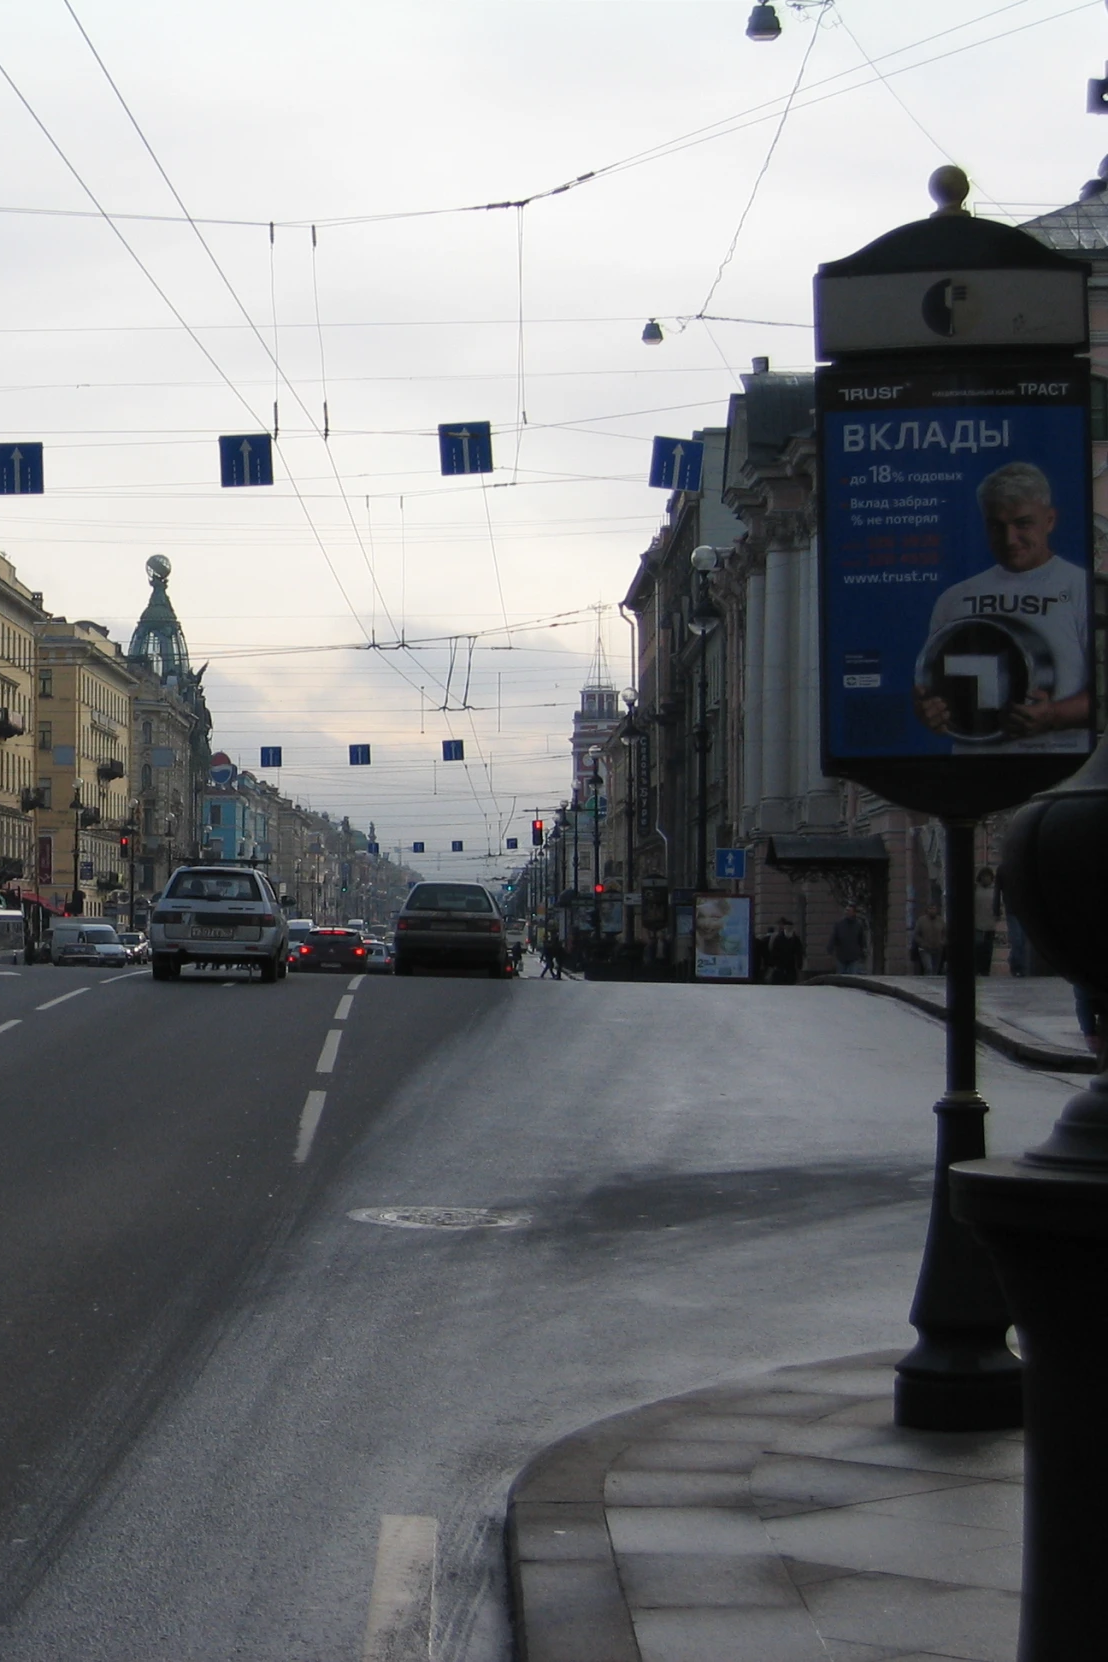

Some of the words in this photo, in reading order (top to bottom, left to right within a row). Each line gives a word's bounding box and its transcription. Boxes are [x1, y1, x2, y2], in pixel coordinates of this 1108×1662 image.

[838, 386, 904, 401] TRUST
[1018, 382, 1069, 396] ТРАСТ
[843, 420, 1010, 454] ВКЛАДЫ
[849, 475, 867, 487] до
[908, 471, 964, 484] годовых
[850, 497, 890, 510] Вклад
[893, 495, 937, 510] забрал
[867, 516, 882, 525] не
[886, 514, 938, 527] потерял
[843, 570, 938, 584] www.trust.ru
